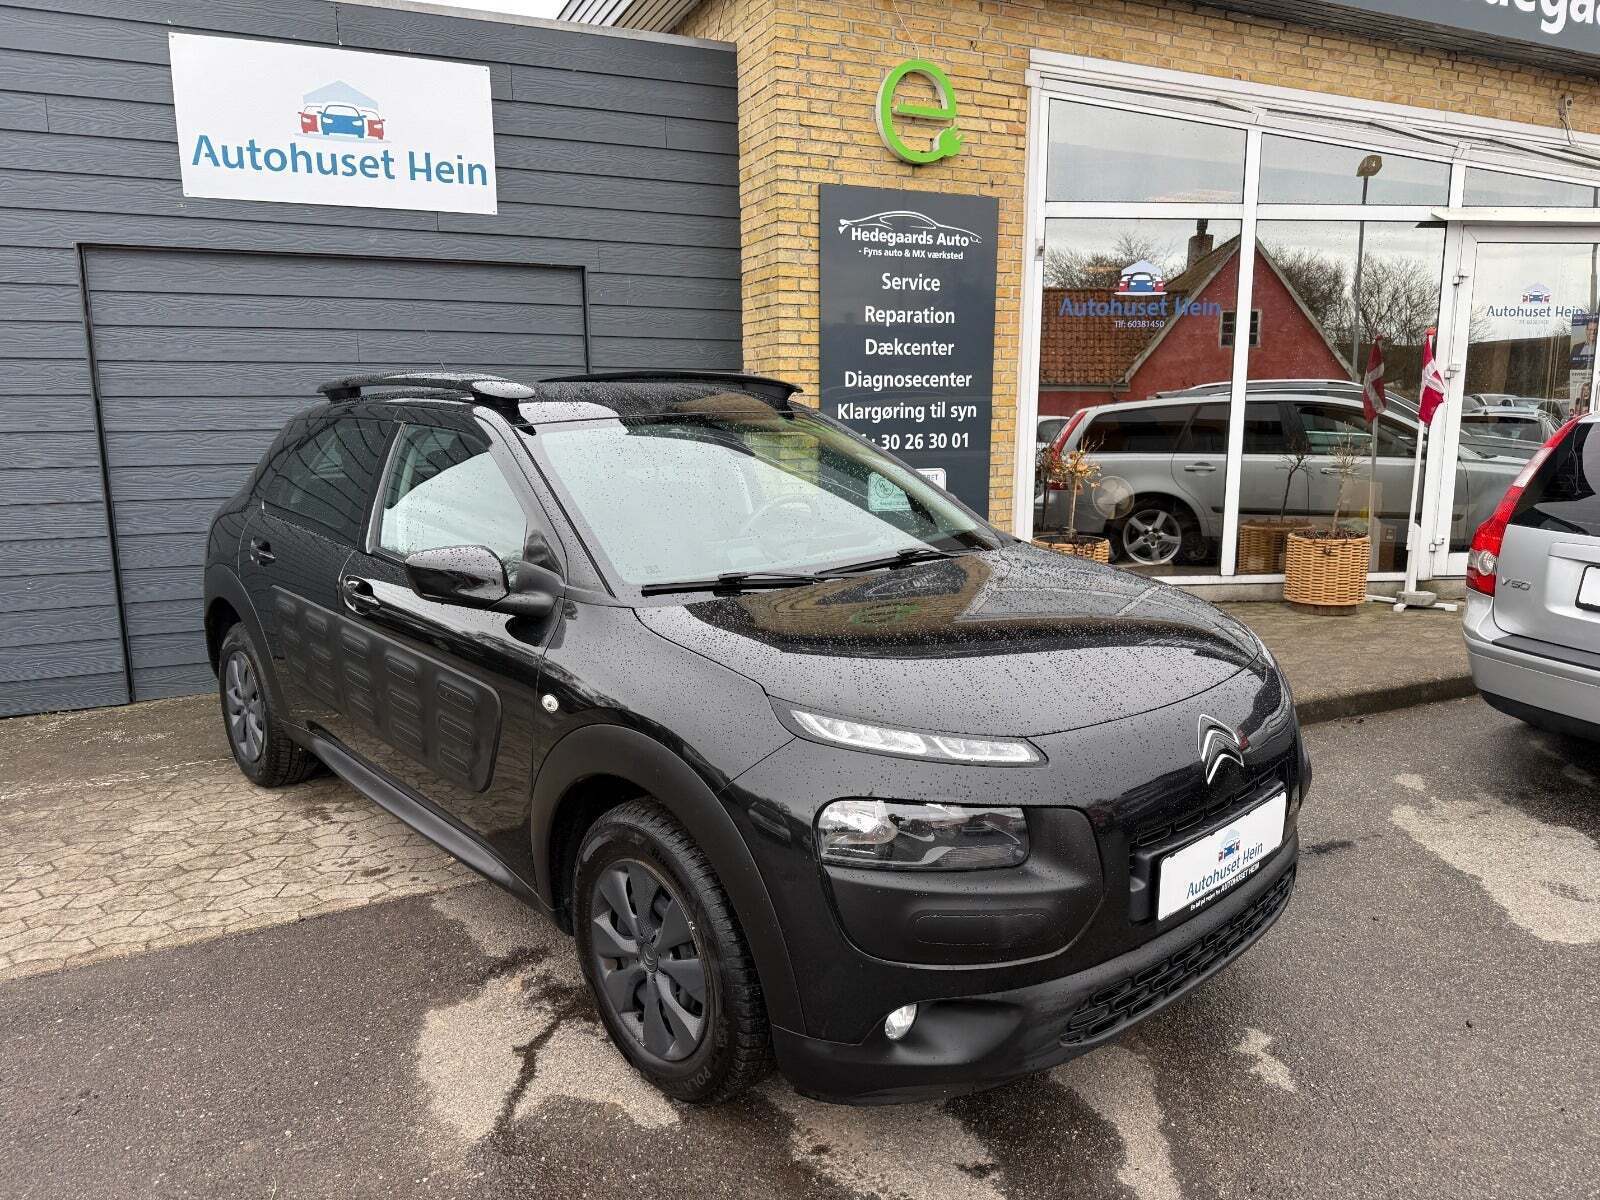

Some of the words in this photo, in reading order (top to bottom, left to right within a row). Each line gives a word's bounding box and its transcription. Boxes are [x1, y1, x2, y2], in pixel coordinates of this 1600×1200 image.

[191, 134, 396, 180] Autohuset
[408, 151, 488, 186] Hein
[851, 228, 934, 246] Hedegaards
[936, 232, 970, 247] Auto
[863, 247, 882, 258] Fyns
[884, 249, 903, 257] auto
[904, 249, 911, 258] &
[912, 249, 926, 258] MX
[927, 250, 964, 260] værksted
[881, 272, 941, 291] Service
[865, 305, 955, 327] Reparation
[1059, 297, 1168, 318] Autohuset
[1175, 297, 1222, 317] Hein
[1486, 305, 1552, 318] Autohuset
[865, 338, 954, 356] Dækcenter
[844, 371, 972, 391] Diagnosecenter
[837, 403, 925, 423] Klargøring
[930, 401, 946, 418] til
[950, 404, 977, 422] syn
[881, 434, 901, 450] 30
[904, 433, 924, 450] 26
[928, 433, 948, 449] 30
[951, 432, 969, 448] 01
[1187, 854, 1240, 899] Autohuset
[1243, 842, 1263, 865] Hein
